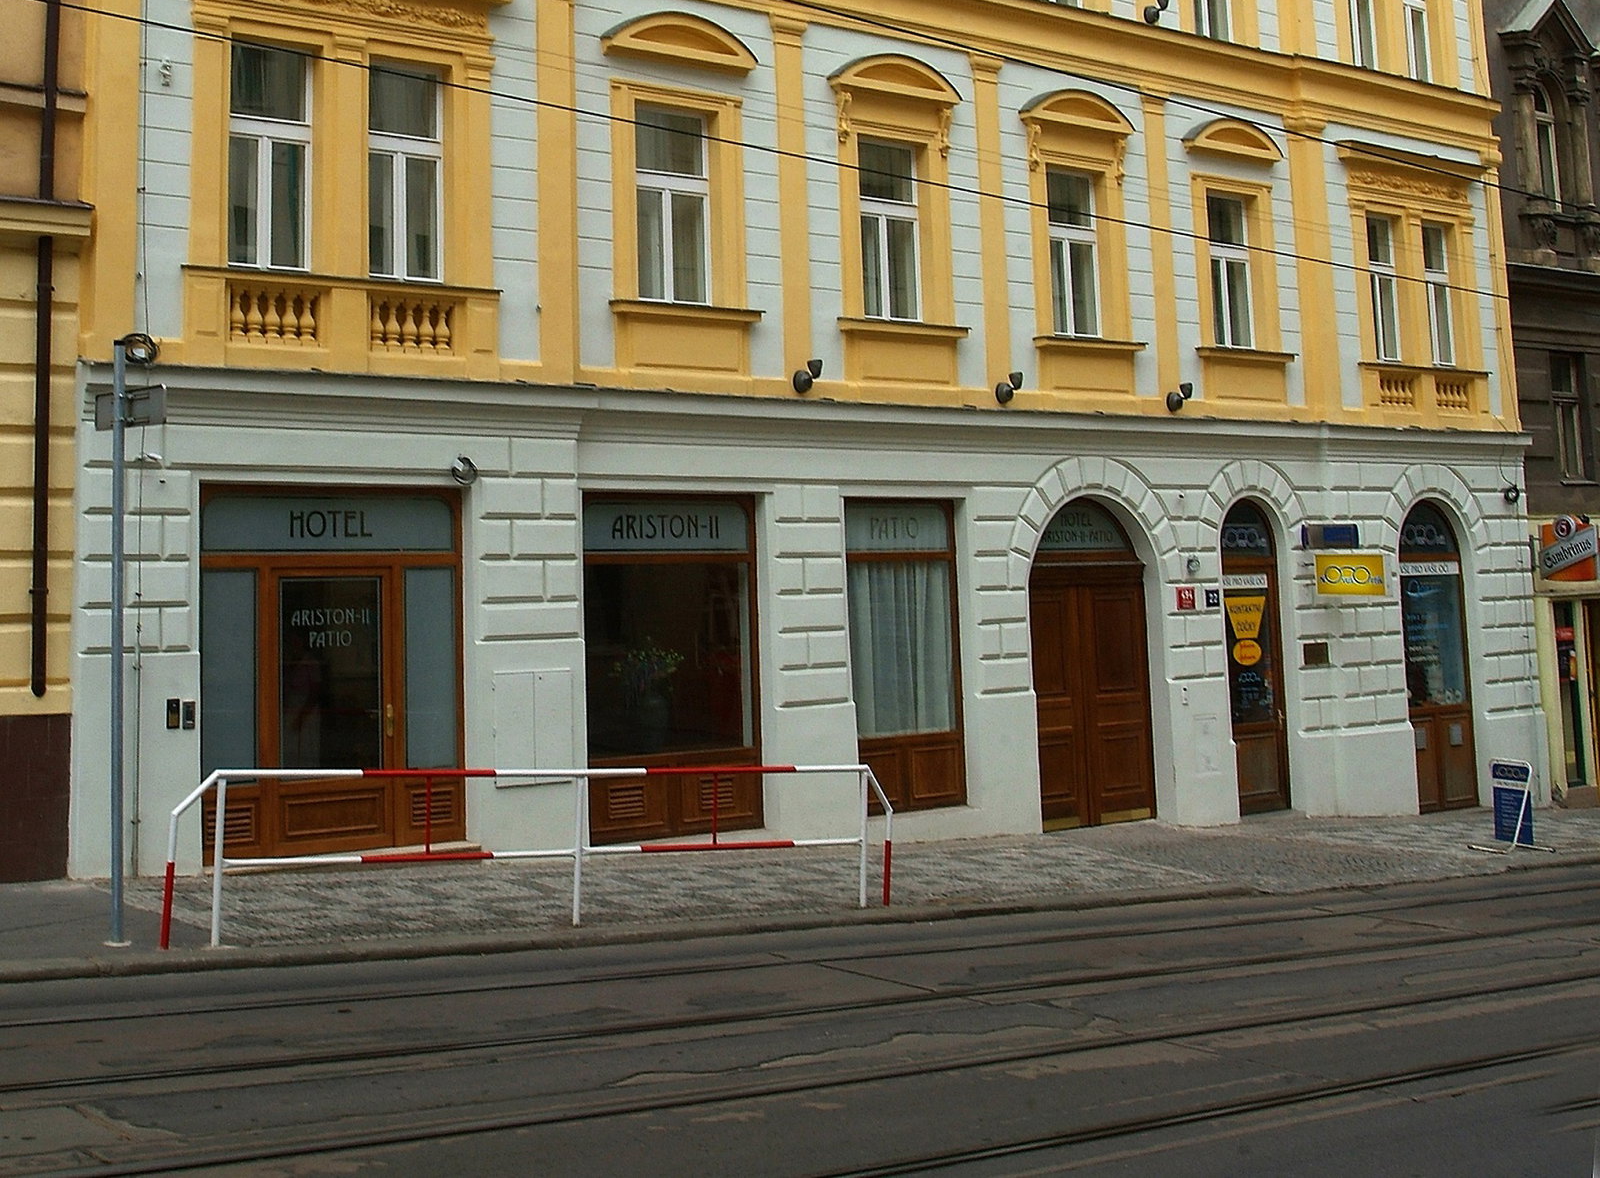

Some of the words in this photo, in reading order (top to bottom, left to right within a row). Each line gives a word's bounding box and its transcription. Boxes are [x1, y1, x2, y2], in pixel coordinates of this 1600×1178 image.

[289, 510, 373, 538] HOTEL
[611, 514, 720, 539] ARISTON-II
[870, 517, 919, 540] PATIO
[1060, 511, 1093, 527] HOTEL
[1543, 538, 1592, 569] Gambrinus
[1209, 592, 1218, 603] 22
[291, 608, 370, 626] ARISTON-II
[309, 630, 352, 649] PATIO
